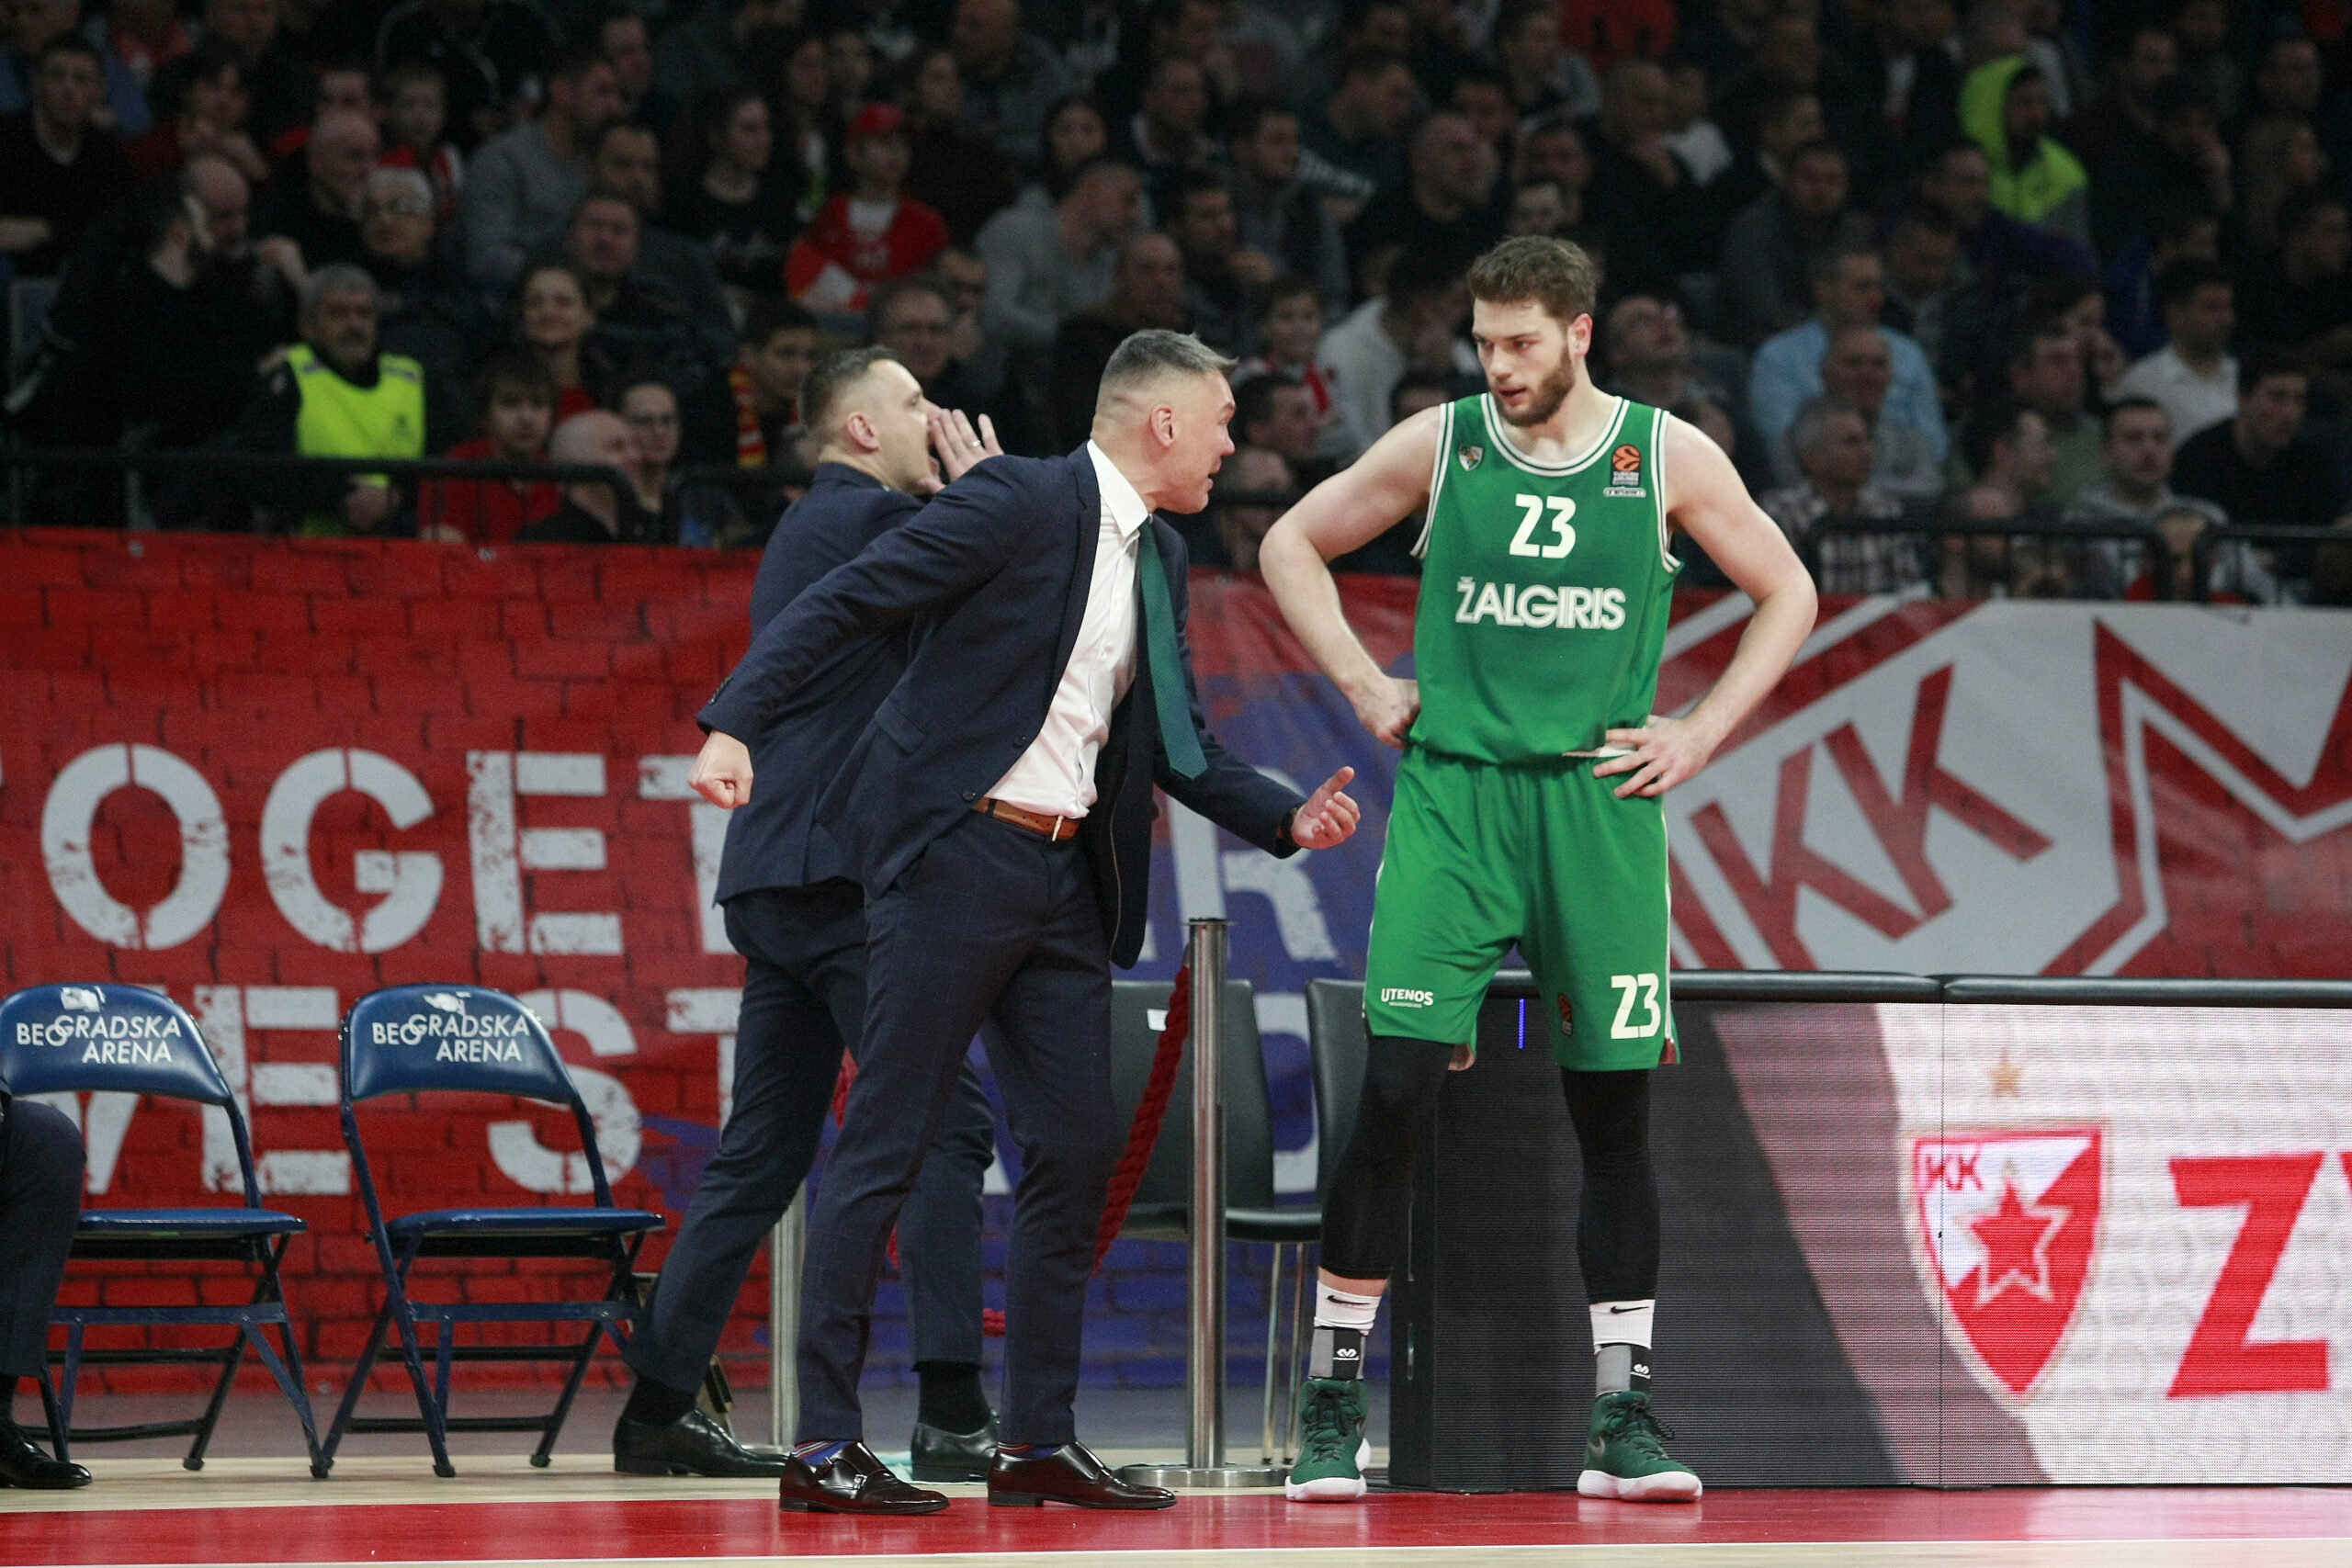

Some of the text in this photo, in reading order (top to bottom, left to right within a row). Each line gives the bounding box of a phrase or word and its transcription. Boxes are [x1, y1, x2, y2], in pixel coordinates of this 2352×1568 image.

[1510, 493, 1577, 558] 23
[1455, 576, 1626, 630] ŽALGIRIS
[1381, 988, 1434, 1006] UTENOS
[1611, 973, 1661, 1040] 23
[17, 1015, 182, 1046] BEOGRADSKA
[372, 1013, 530, 1045] BEOGRADSKA
[82, 1041, 173, 1065] ARENA
[435, 1039, 522, 1063] ARENA
